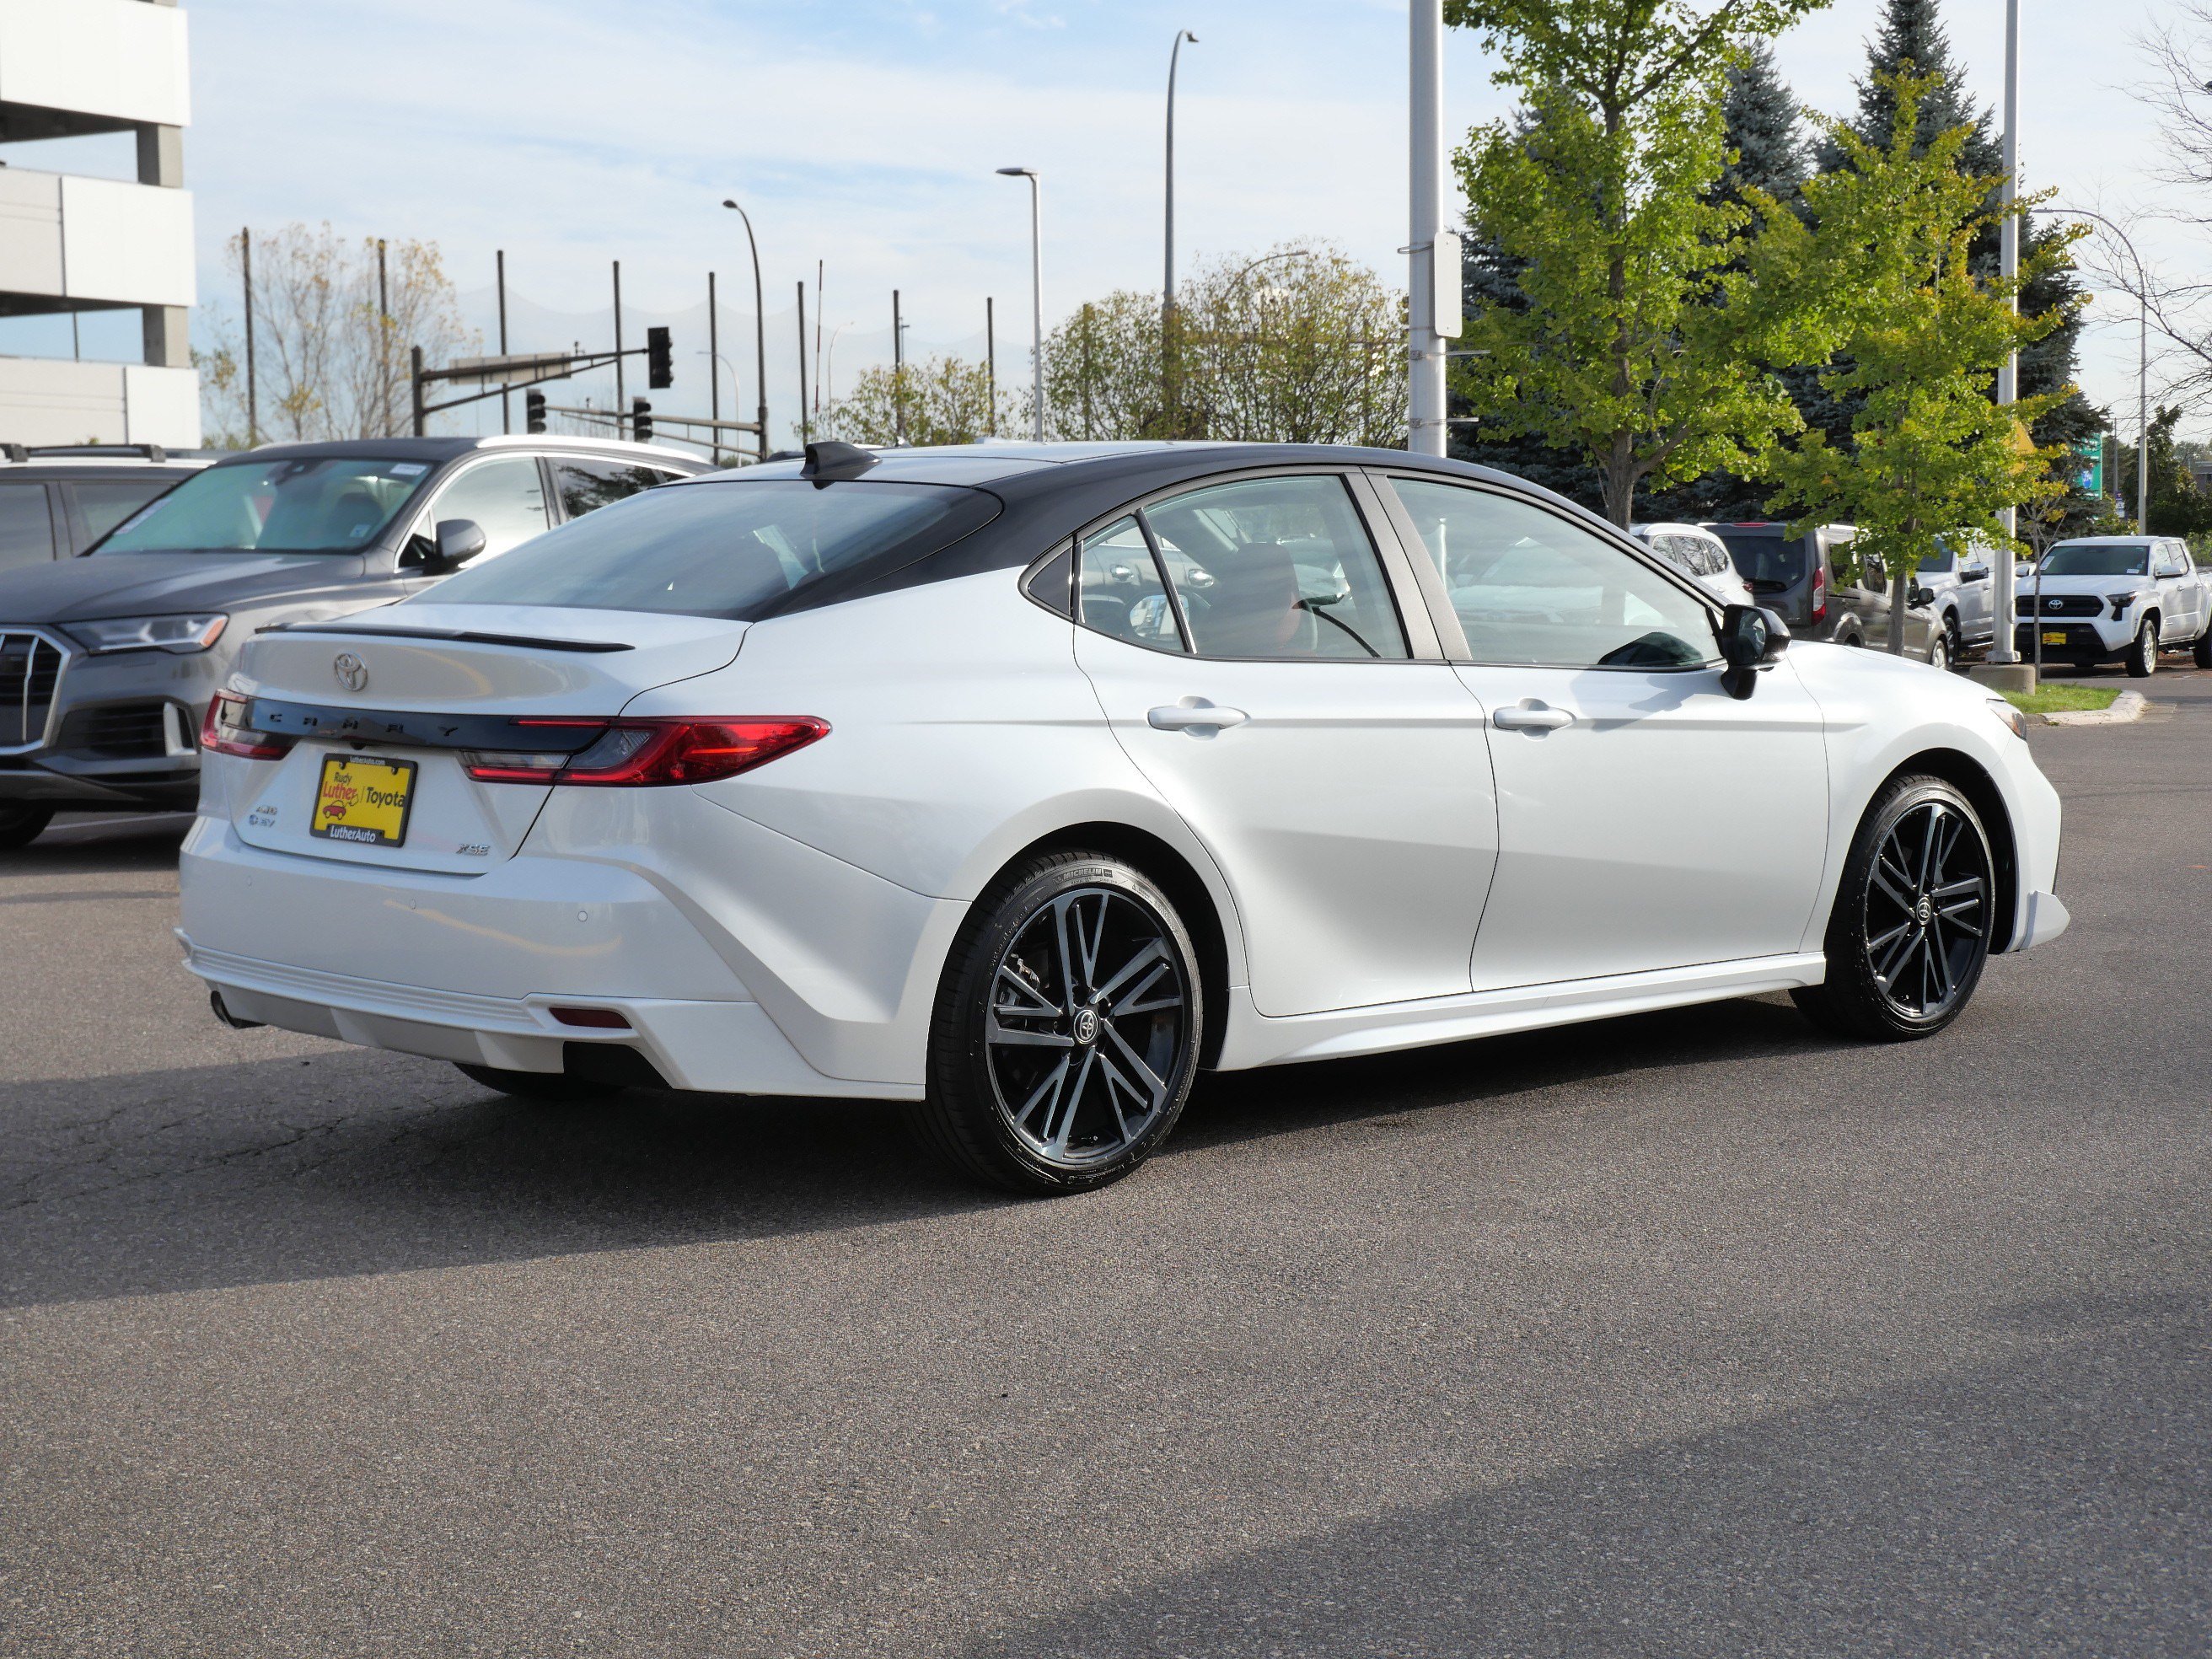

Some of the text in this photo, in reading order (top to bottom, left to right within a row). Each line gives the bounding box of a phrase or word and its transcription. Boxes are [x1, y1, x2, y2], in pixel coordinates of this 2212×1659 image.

[270, 713, 458, 737] CAMRY
[334, 772, 352, 786] Rudy
[323, 781, 357, 800] Luther
[366, 787, 405, 808] Toyota
[330, 825, 376, 842] LutherAuto
[456, 843, 490, 856] XSE
[1063, 868, 1102, 880] MICHELIN
